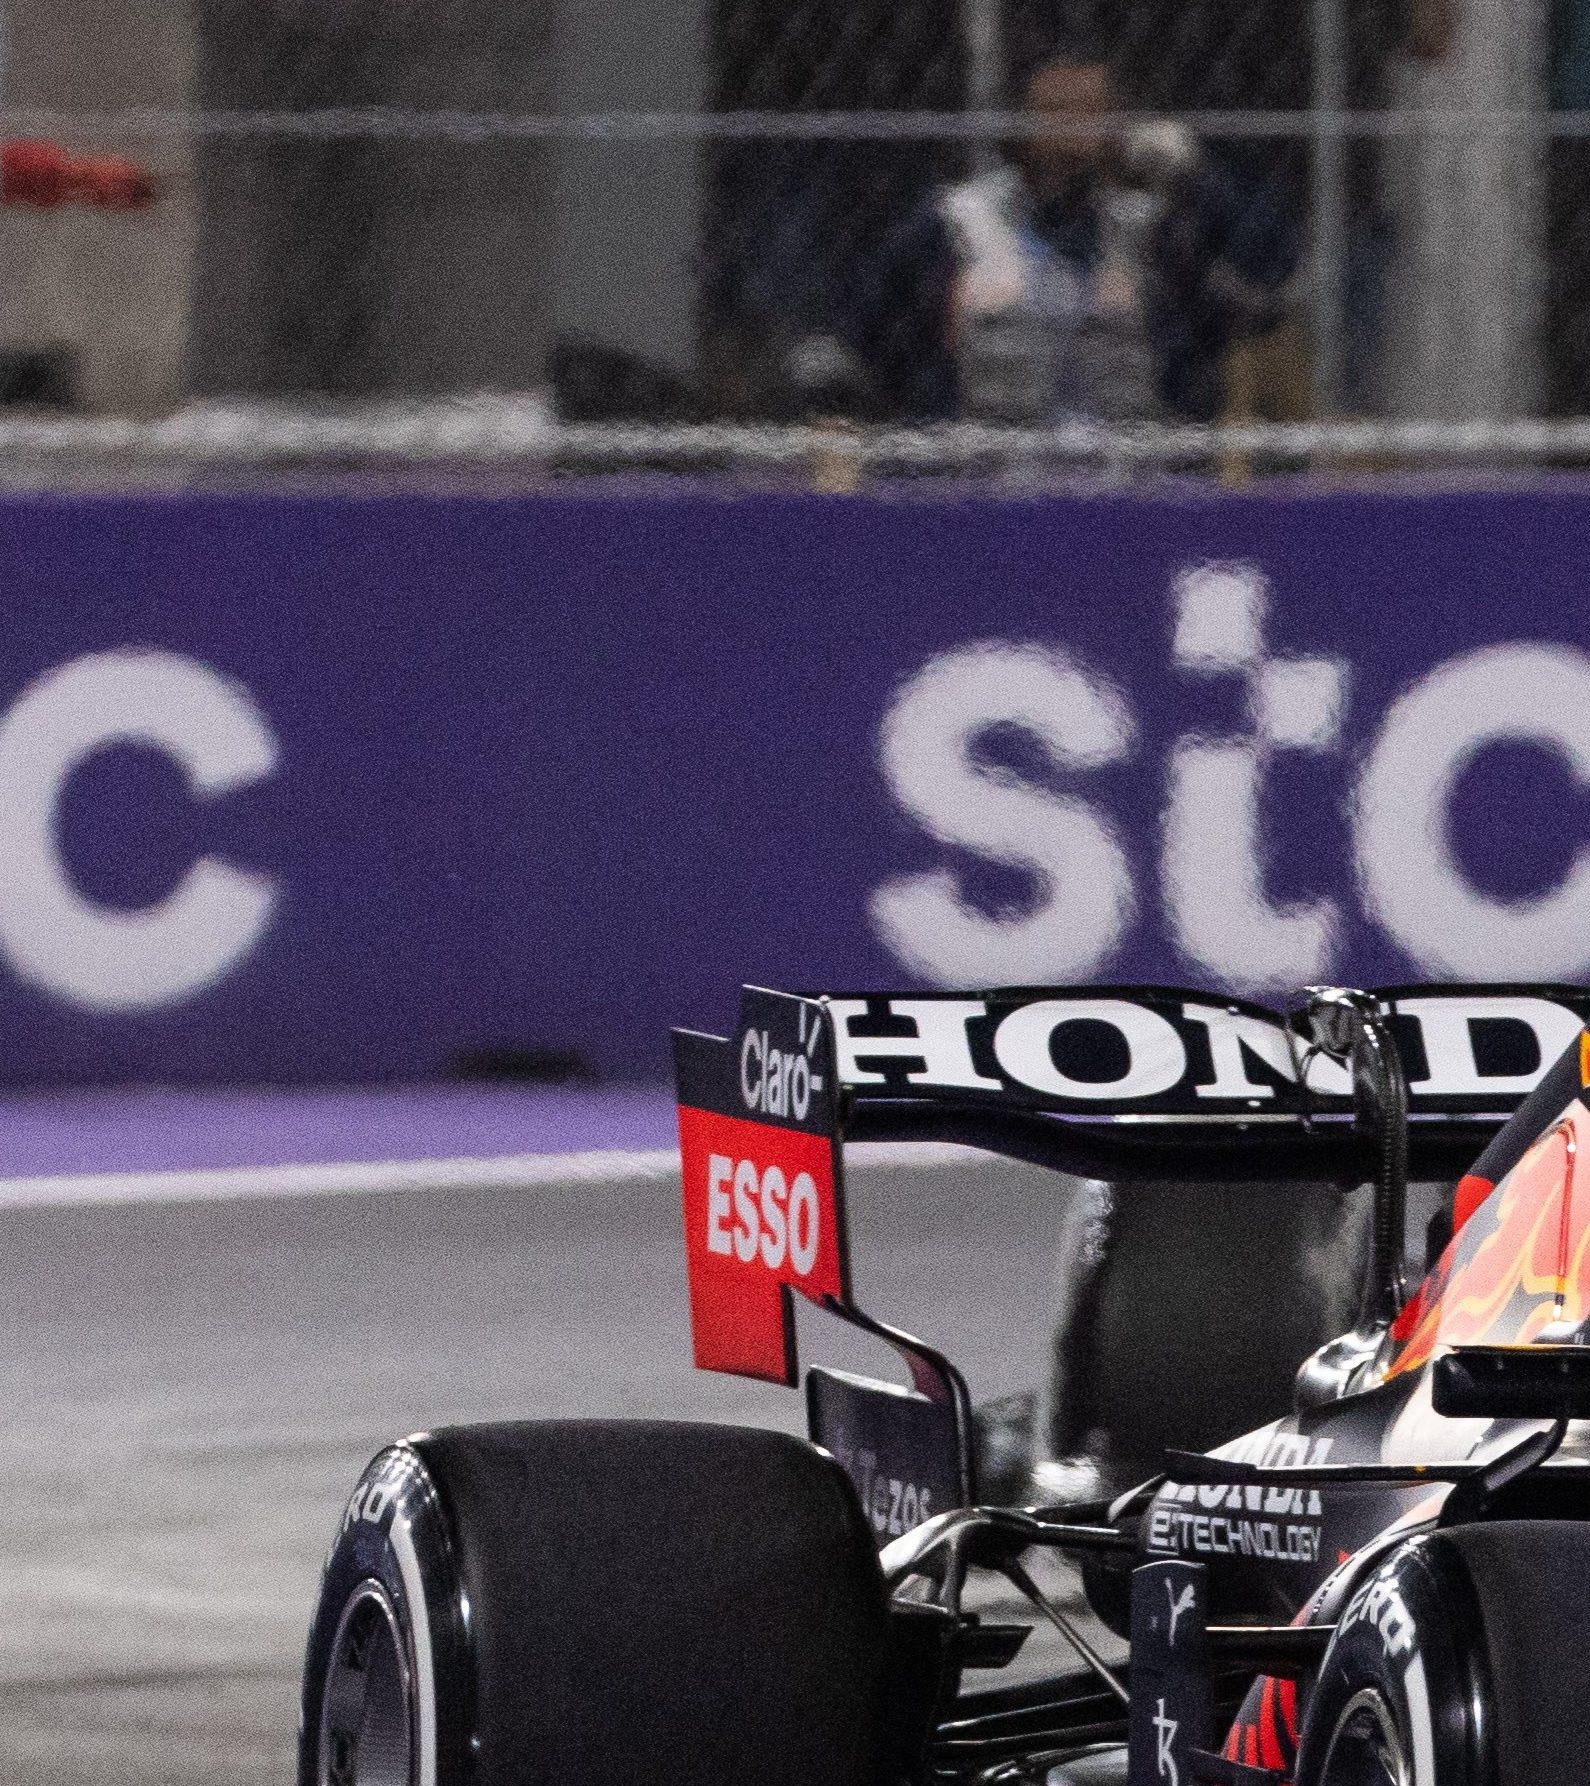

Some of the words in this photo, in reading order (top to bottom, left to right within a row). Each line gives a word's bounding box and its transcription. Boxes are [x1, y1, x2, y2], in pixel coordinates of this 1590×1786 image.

[741, 1028, 811, 1121] Claro
[837, 998, 1585, 1100] HOND
[707, 1152, 820, 1276] ESSO
